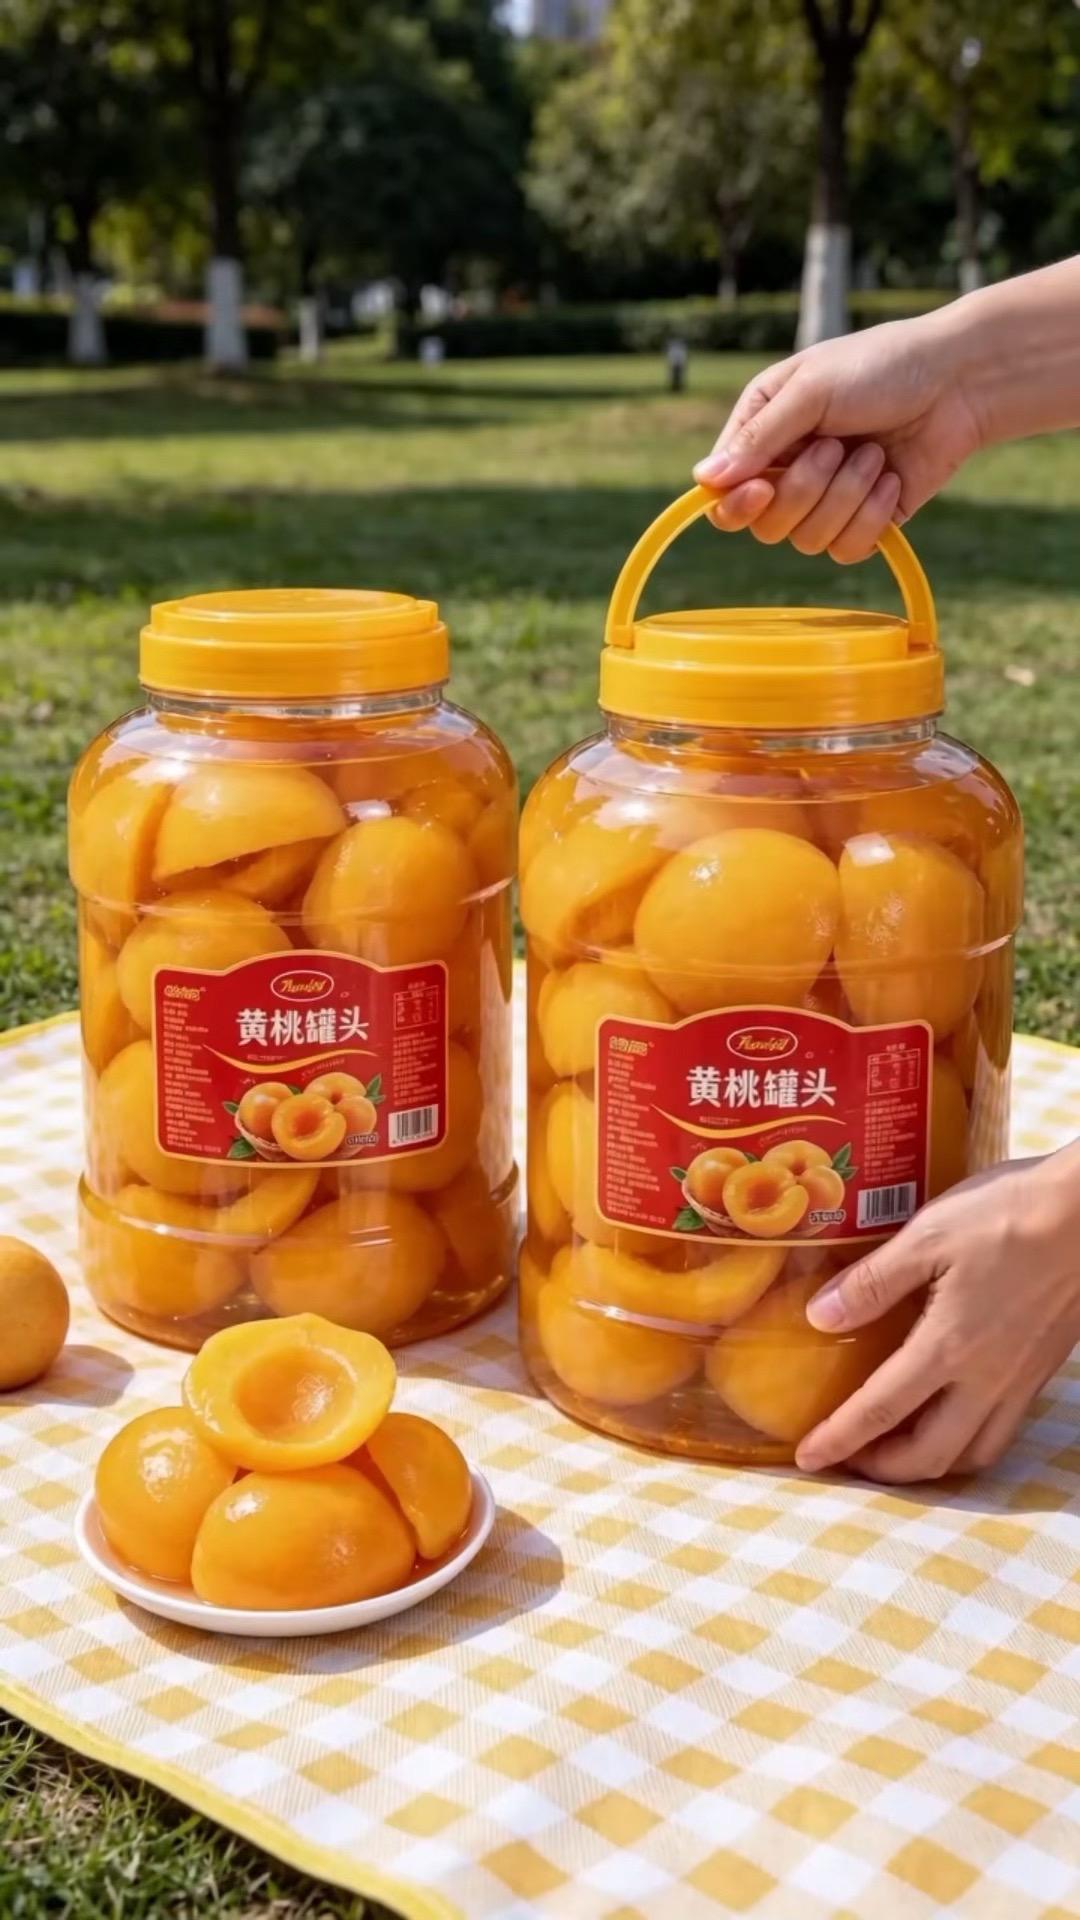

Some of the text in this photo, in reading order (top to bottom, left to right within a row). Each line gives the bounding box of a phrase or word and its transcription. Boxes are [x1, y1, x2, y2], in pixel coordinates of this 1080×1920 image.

[236, 1006, 369, 1047] 黄桃罐头
[686, 1066, 837, 1109] 黄桃罐头
